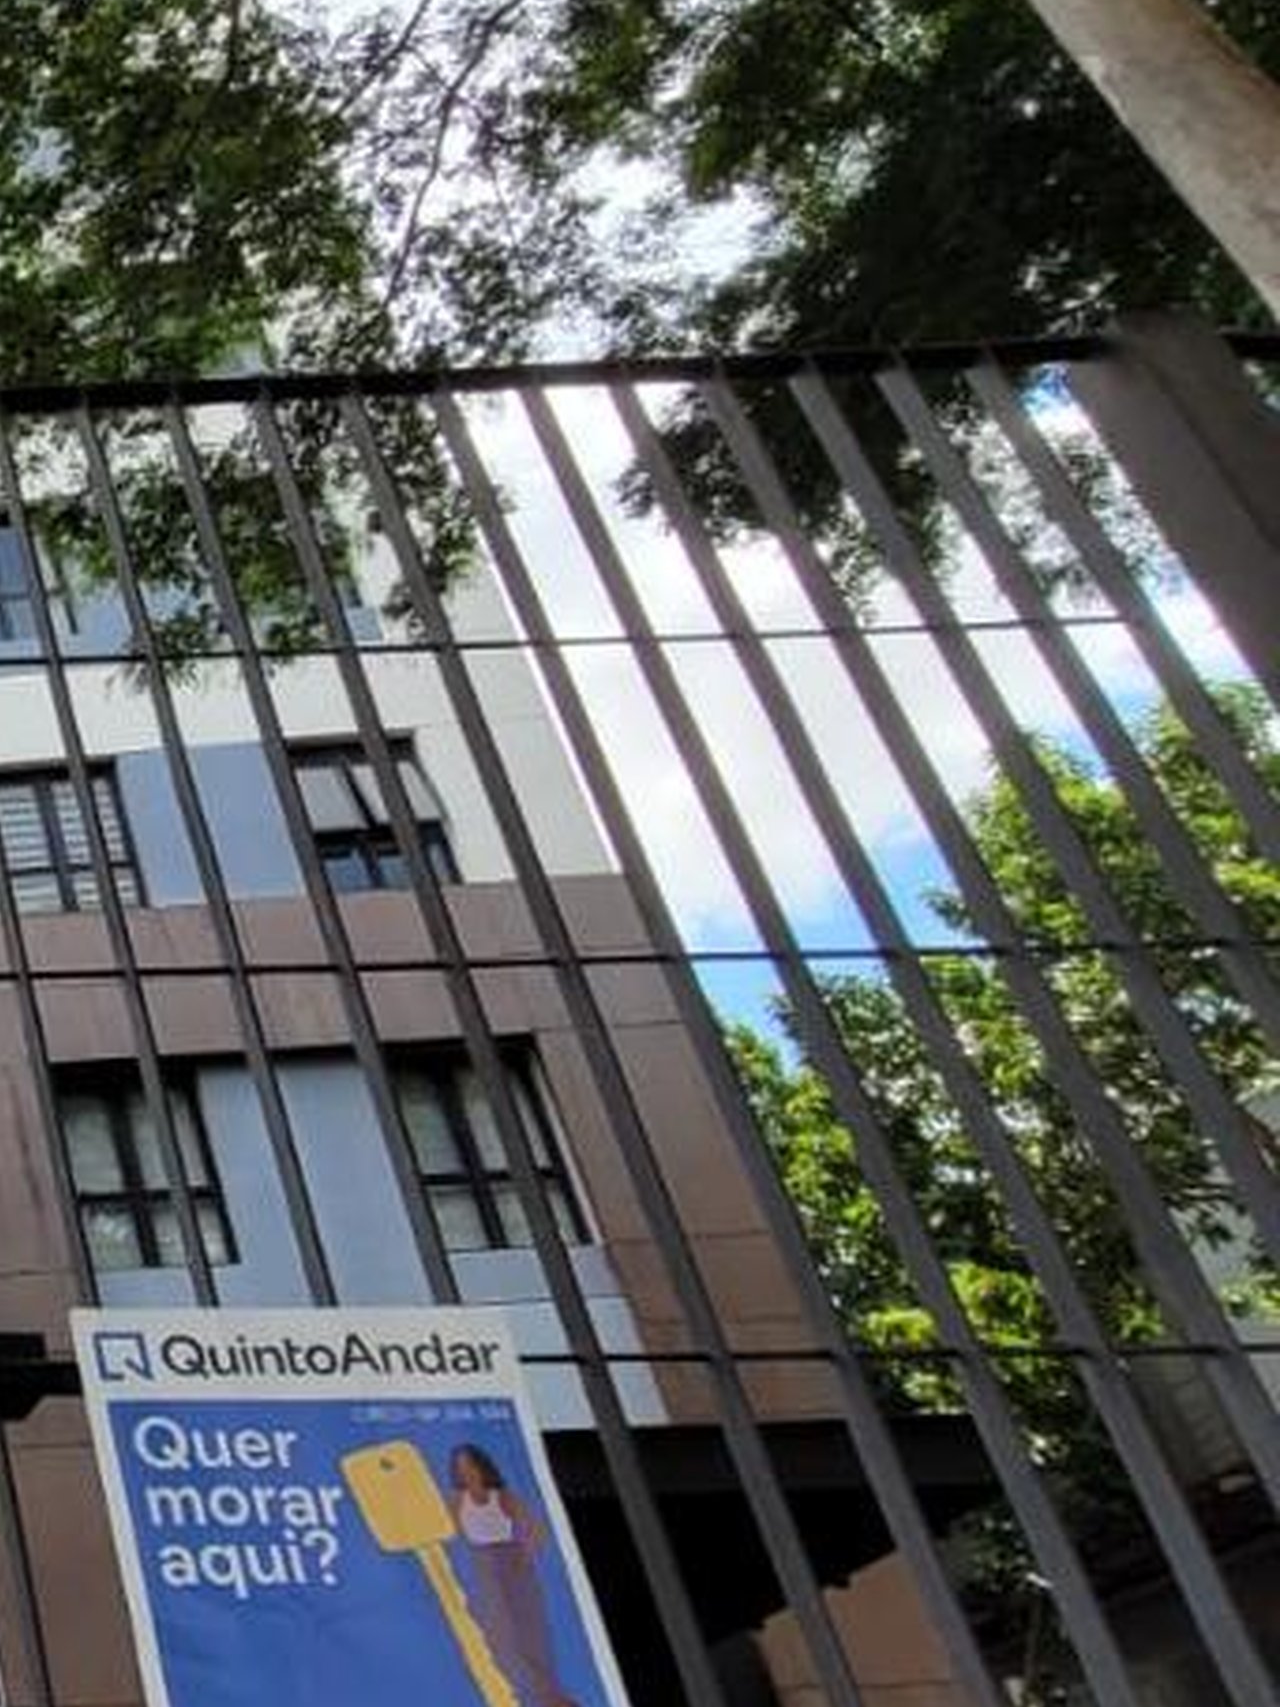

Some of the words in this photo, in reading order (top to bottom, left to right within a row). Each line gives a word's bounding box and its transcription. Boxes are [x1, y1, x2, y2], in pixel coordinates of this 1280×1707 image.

[161, 1332, 501, 1379] QuintoAndar
[134, 1415, 298, 1470] Quer
[145, 1485, 342, 1526] morar
[158, 1528, 339, 1599] aqui?
